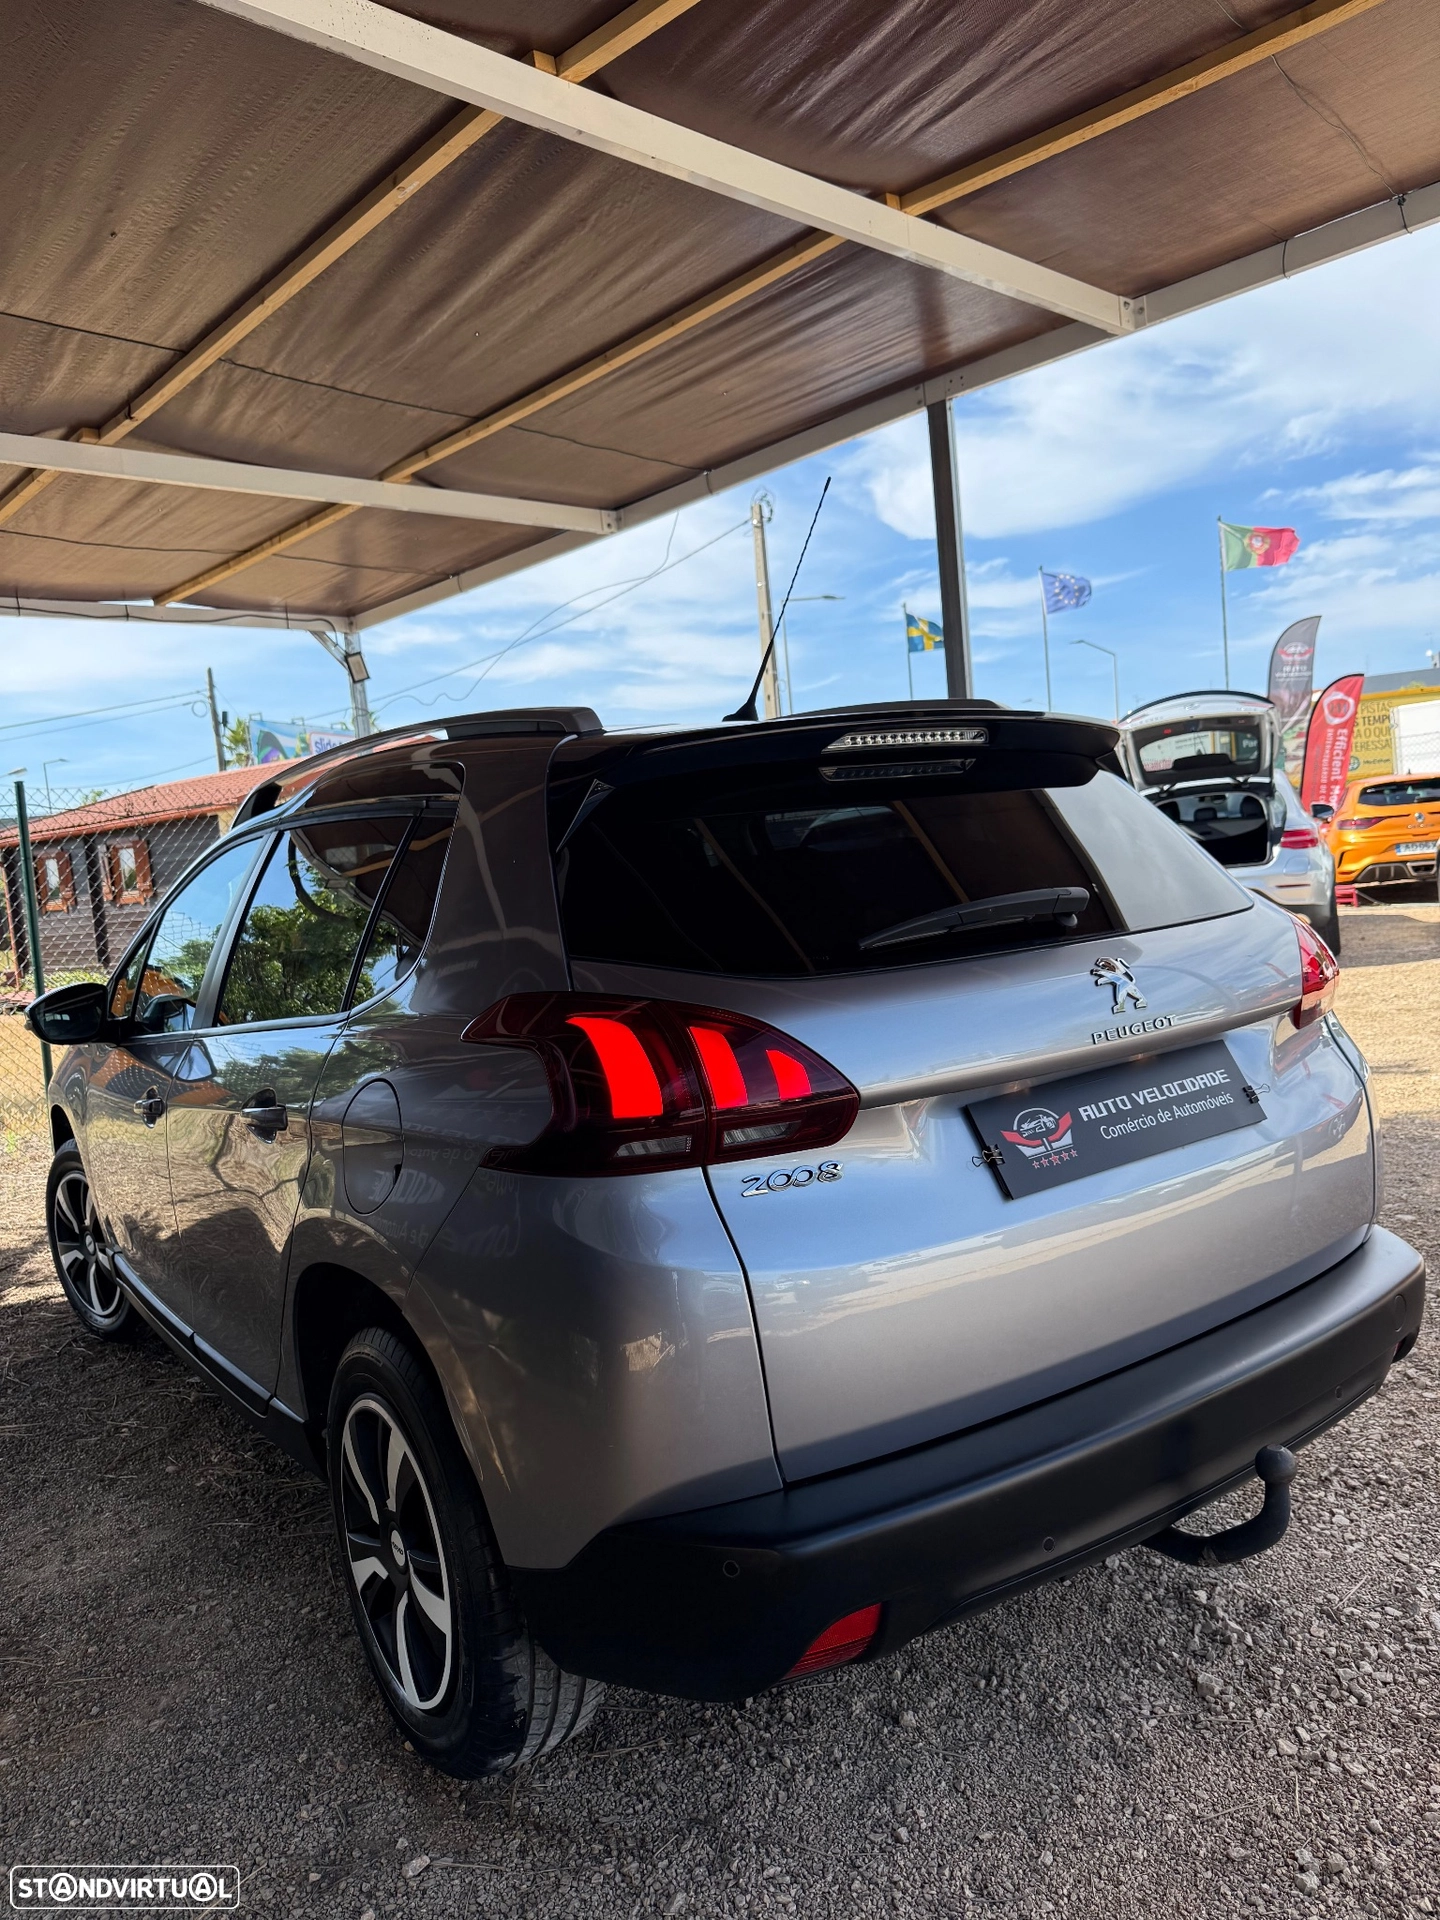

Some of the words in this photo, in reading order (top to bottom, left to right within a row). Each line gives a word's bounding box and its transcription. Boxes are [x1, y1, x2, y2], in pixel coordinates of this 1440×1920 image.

[1330, 728, 1349, 782] Efficient
[1364, 728, 1371, 739] O
[1091, 1014, 1177, 1045] PEUGEOT
[1078, 1095, 1132, 1122] AUTO
[1131, 1069, 1231, 1107] VELOCIDADE
[1100, 1114, 1156, 1140] Comércio
[1157, 1109, 1173, 1123] de
[1175, 1091, 1234, 1119] Automóveis
[741, 1160, 843, 1198] 2008
